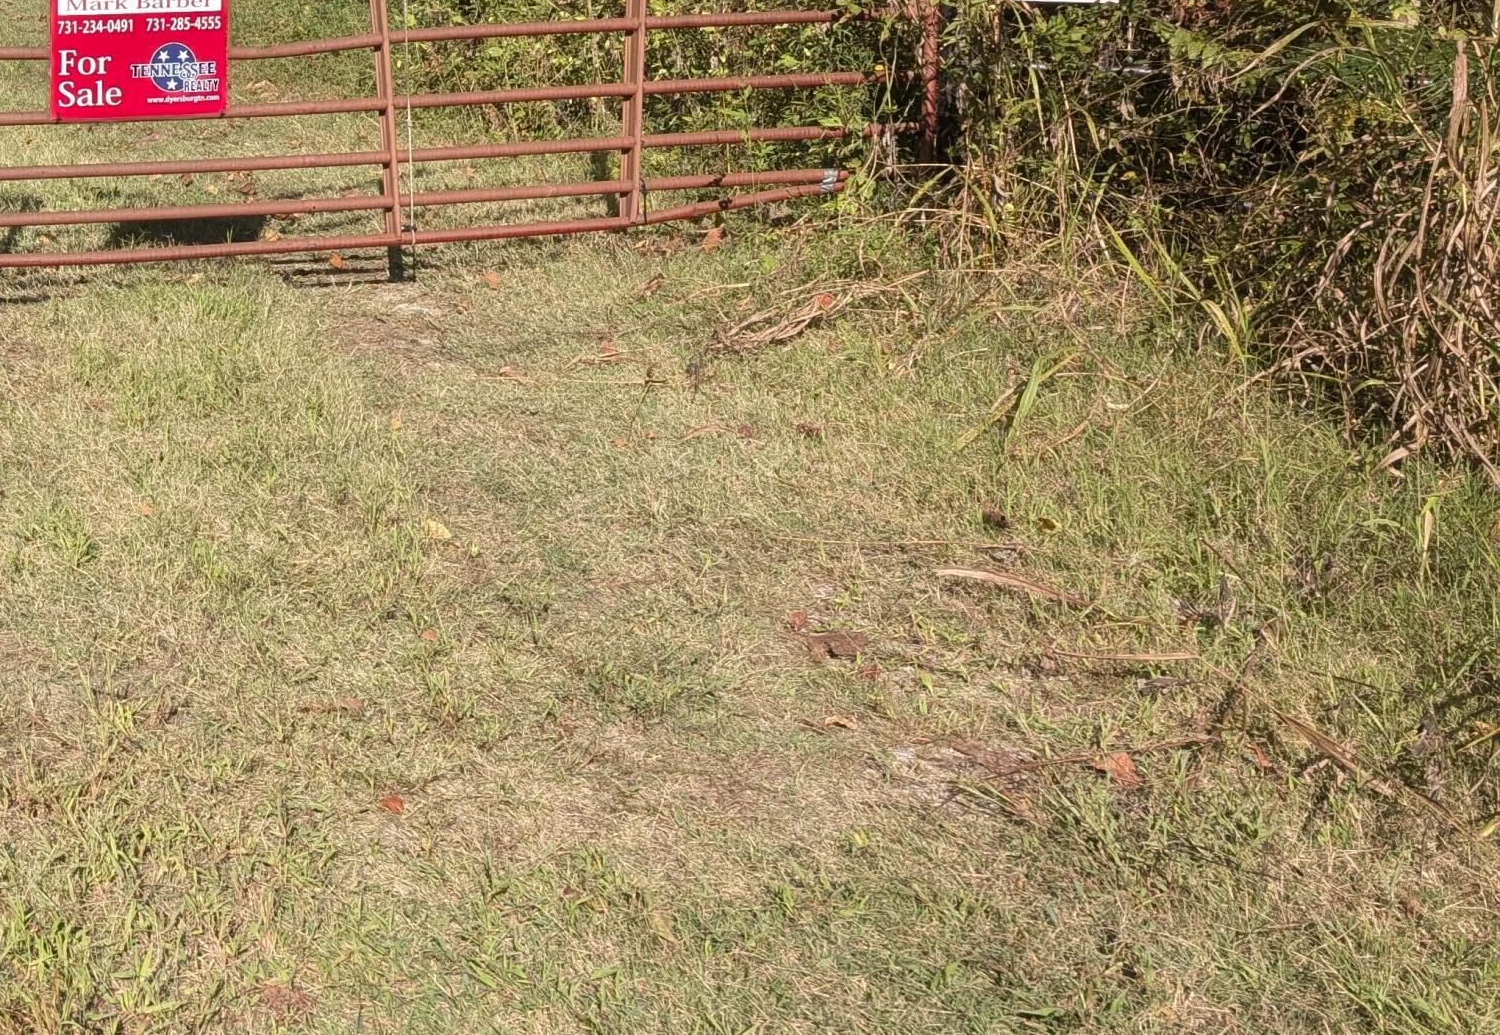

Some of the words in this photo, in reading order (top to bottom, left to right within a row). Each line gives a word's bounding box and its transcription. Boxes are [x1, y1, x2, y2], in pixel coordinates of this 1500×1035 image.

[57, 19, 134, 35] 731-234-0491
[146, 16, 221, 32] 731-285-4555
[58, 49, 112, 76] For
[130, 61, 217, 79] TENNESSEE
[58, 80, 123, 108] Sale
[183, 78, 219, 92] REALTY
[146, 94, 220, 104] www.dyersburgtn.com
